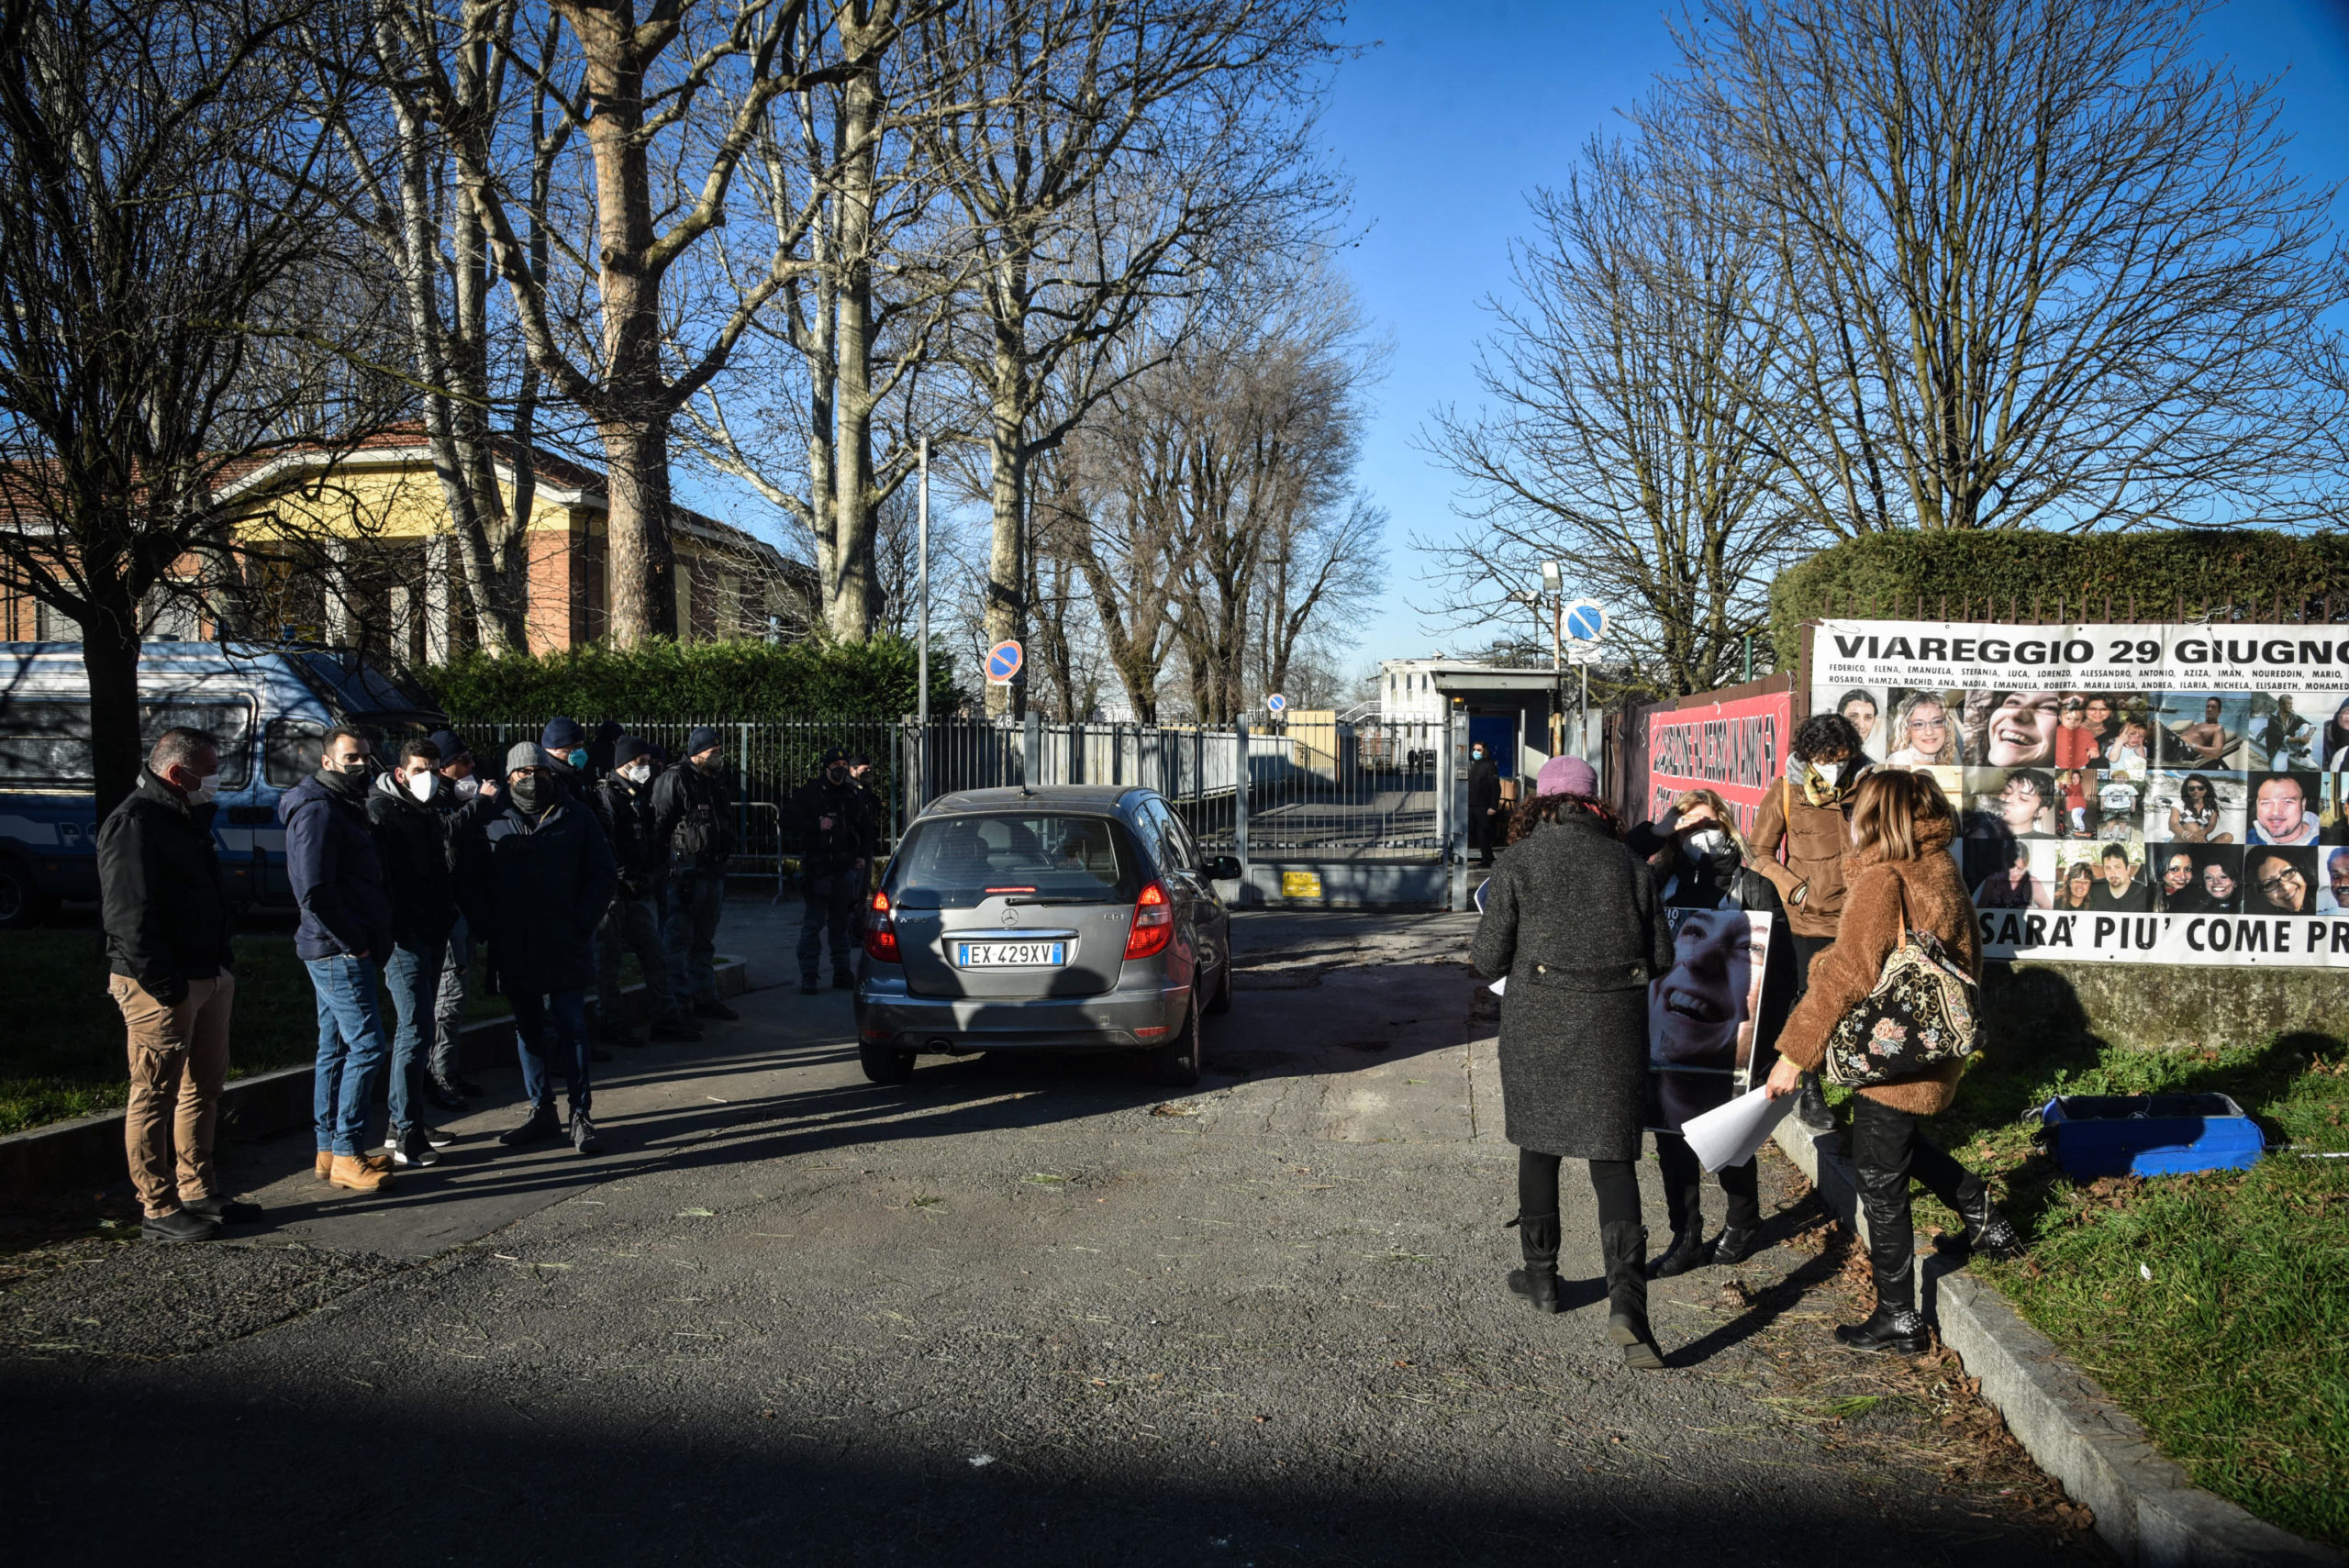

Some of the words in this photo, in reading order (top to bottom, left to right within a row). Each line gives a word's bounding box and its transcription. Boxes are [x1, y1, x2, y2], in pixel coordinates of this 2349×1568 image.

[1833, 635, 2094, 664] VIAREGGIO
[2109, 639, 2161, 664] 29
[1829, 663, 1866, 673] FEDERICO,
[1874, 664, 1901, 674] ELENA,
[1908, 665, 1954, 676] EMANUELA,
[1962, 668, 2000, 678] STEFANIA,
[2008, 669, 2031, 679] LUCA,
[2037, 669, 2073, 679] LORENZO,
[2080, 669, 2132, 679] ALESSANDRO,
[2139, 669, 2176, 679] ANTONIO,
[2184, 669, 2211, 679] AZIZA,
[2218, 669, 2244, 679] IMAN,
[2252, 669, 2305, 679] NOUREDDIN,
[2311, 670, 2343, 680] MARIO,
[1829, 675, 1865, 685] ROSARIO,
[1868, 676, 1900, 686] HAMZA,
[1904, 677, 1934, 687] RACHID,
[1937, 678, 1958, 688] ANA,
[1962, 679, 1989, 689] NADIA,
[1994, 681, 2040, 690] EMANUELA,
[2043, 682, 2080, 691] ROBERTA,
[2084, 682, 2111, 691] MARIA
[2113, 682, 2138, 692] LUISA,
[2142, 682, 2176, 692] ANDREA,
[2180, 682, 2210, 692] ILARIA,
[2213, 682, 2253, 692] MICHELA,
[2255, 682, 2301, 692] ELISABETH,
[2094, 917, 2171, 951] PIU'
[2186, 917, 2291, 952] COME
[971, 946, 991, 963] EX
[997, 944, 1051, 963] 429XV
